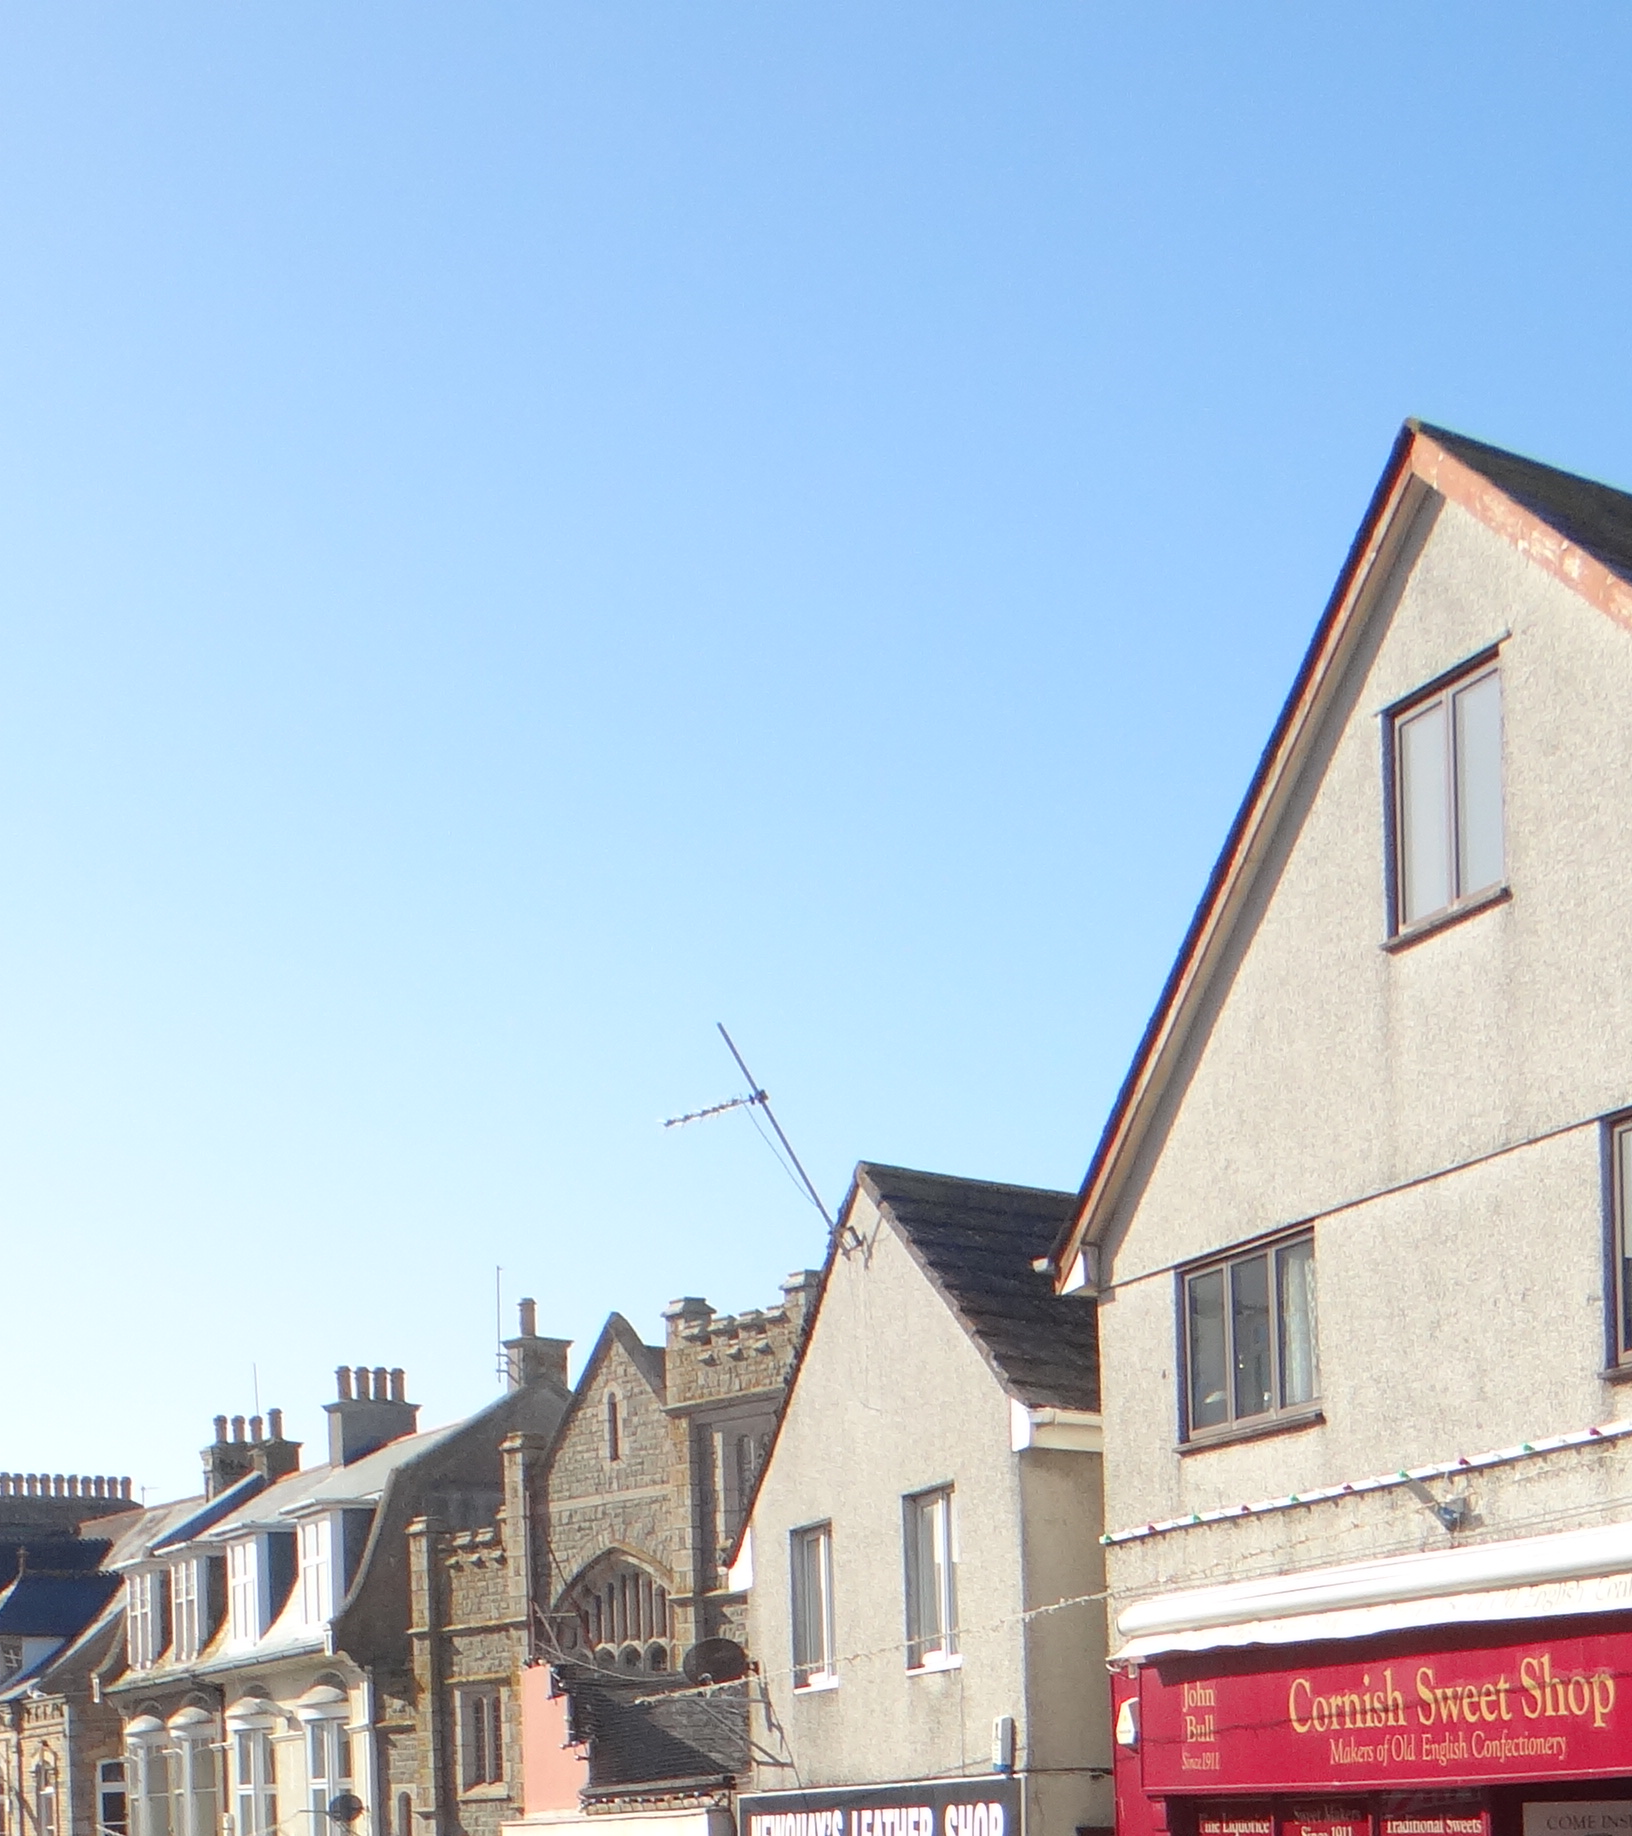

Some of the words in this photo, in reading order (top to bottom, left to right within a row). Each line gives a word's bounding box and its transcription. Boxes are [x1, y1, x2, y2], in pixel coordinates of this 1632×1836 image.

[1183, 1682, 1215, 1712] John
[1288, 1668, 1407, 1733] Cornish
[1416, 1666, 1512, 1726] Sweet
[1520, 1653, 1616, 1728] Shop
[1186, 1713, 1215, 1743] Bull
[1330, 1737, 1375, 1766] Makers
[1376, 1735, 1391, 1766] of
[1391, 1734, 1416, 1762] Old
[1422, 1733, 1468, 1766] English
[1471, 1730, 1567, 1763] Confectionery
[1386, 1813, 1444, 1834] Traditional
[1445, 1813, 1482, 1834] Sweets
[1546, 1814, 1597, 1831] COME
